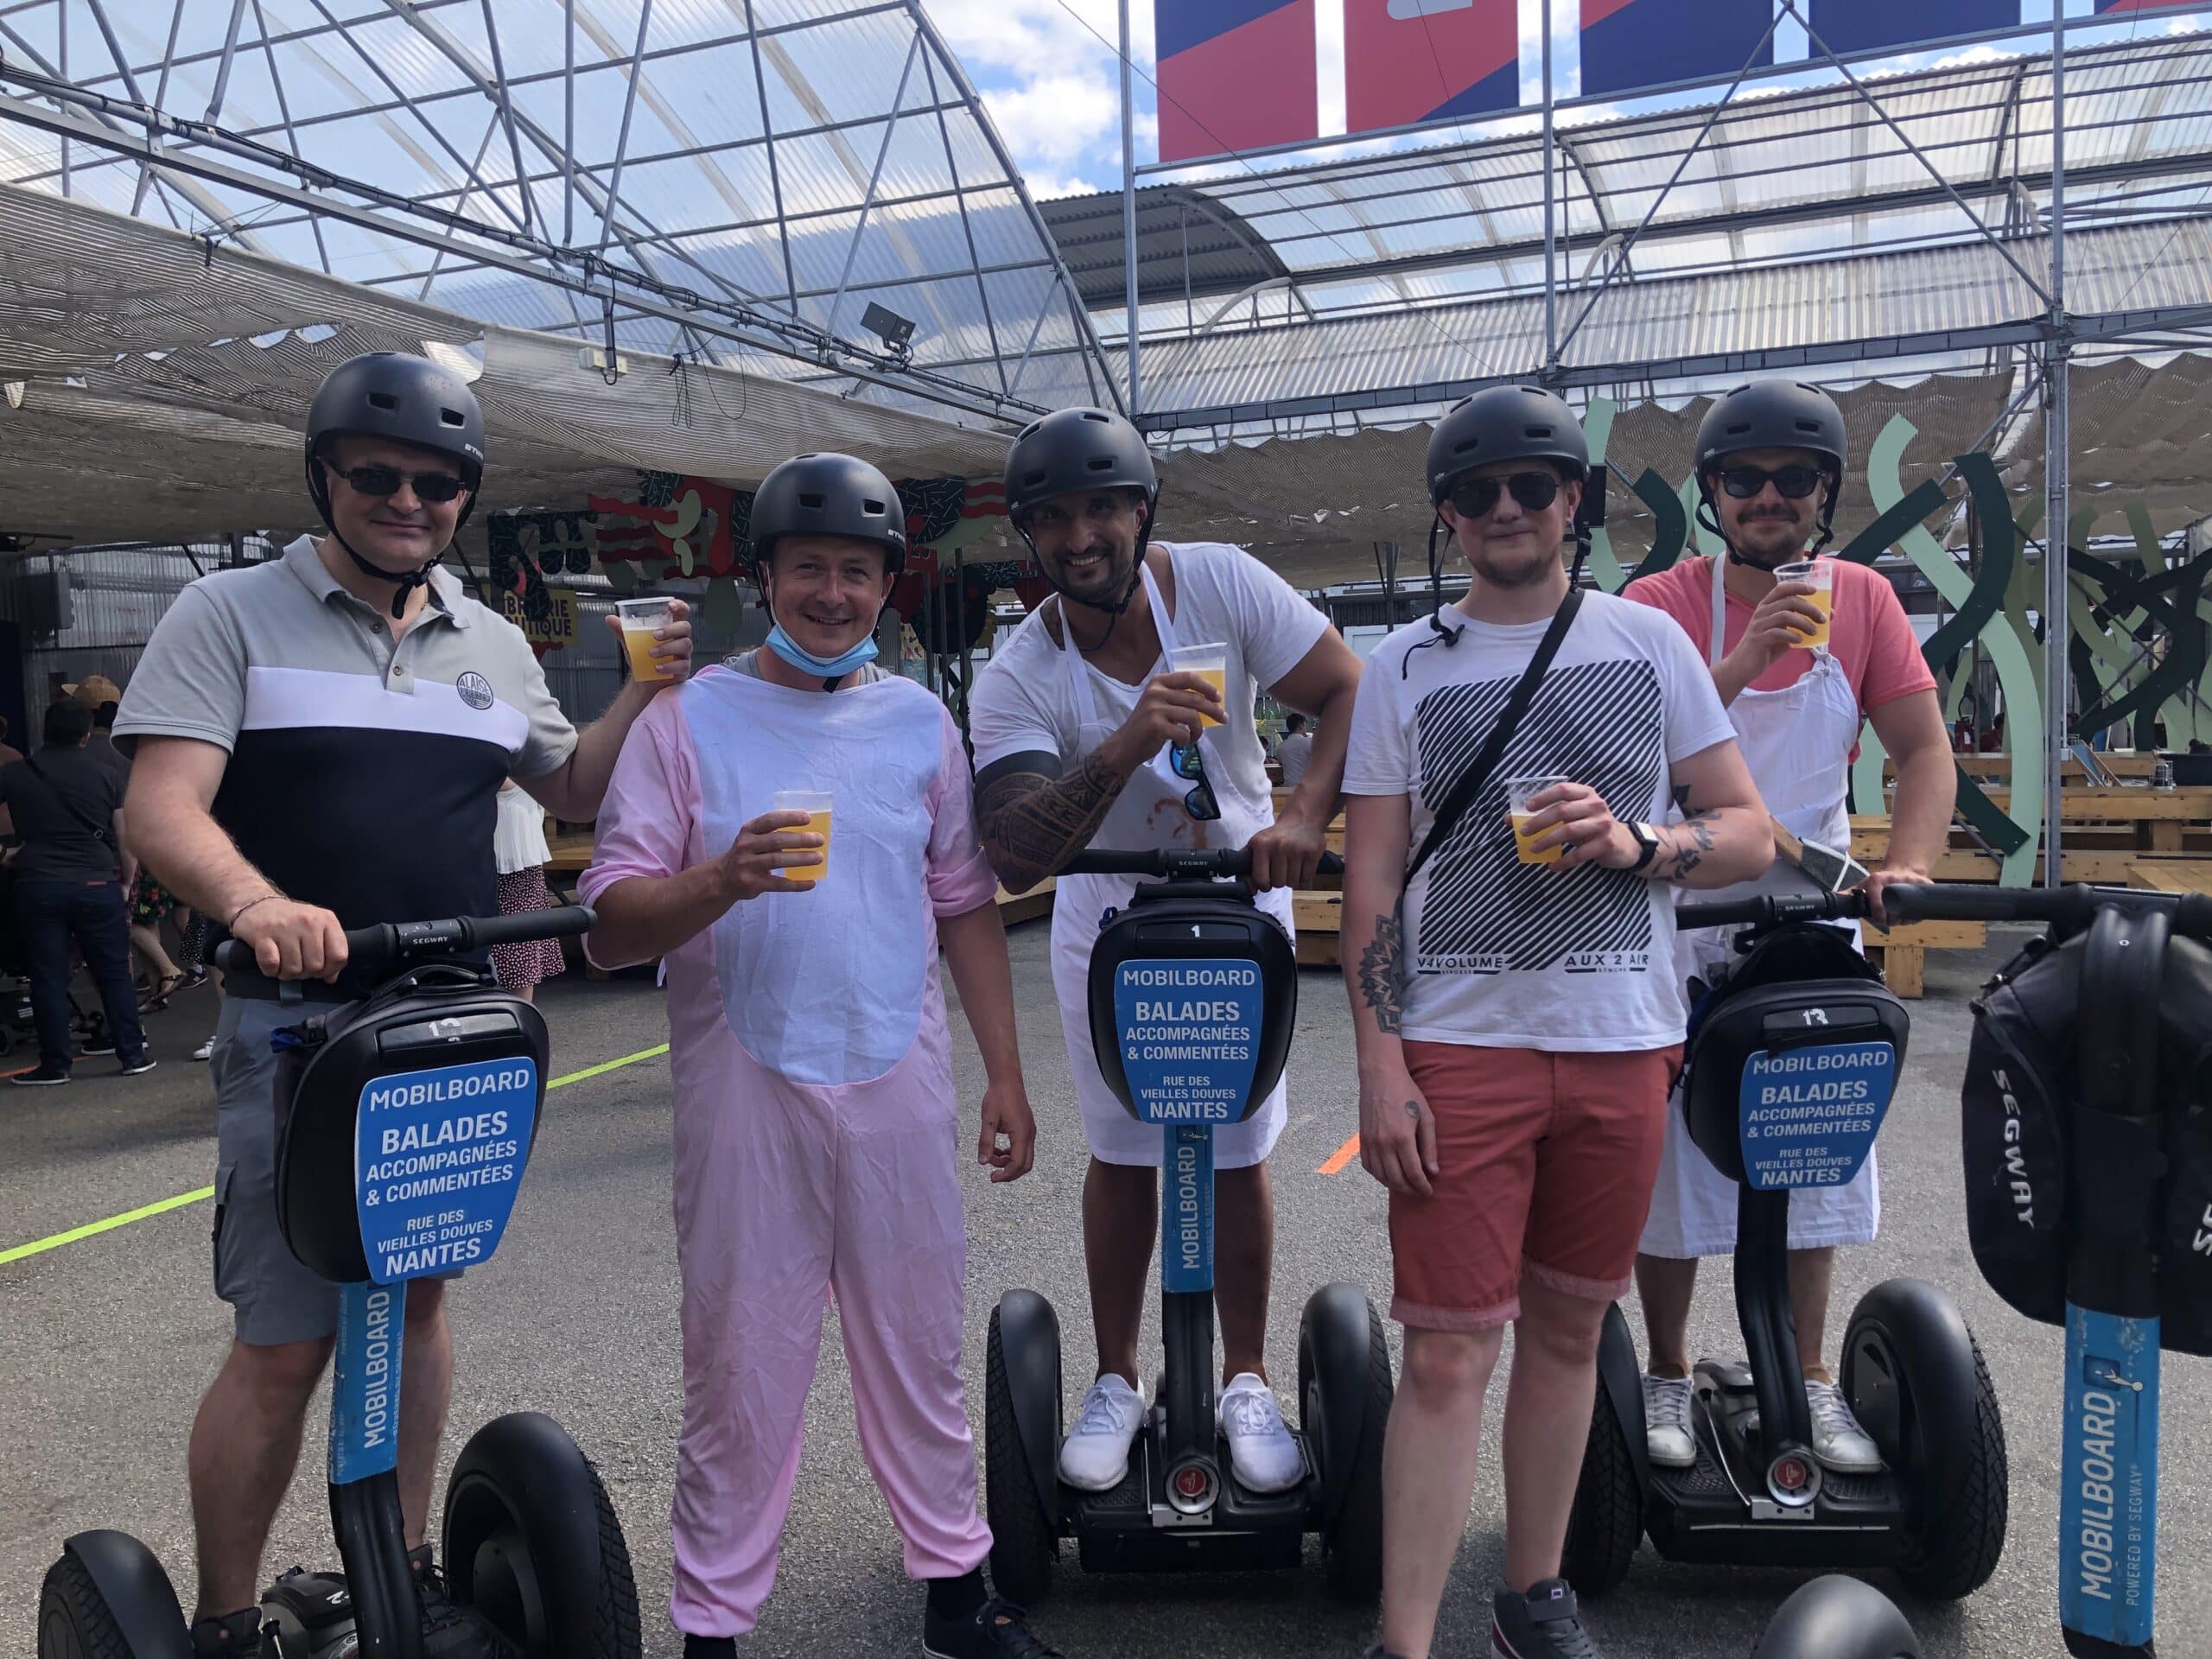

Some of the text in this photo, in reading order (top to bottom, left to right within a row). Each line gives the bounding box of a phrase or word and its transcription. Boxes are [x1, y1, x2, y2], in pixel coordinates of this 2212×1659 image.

[413, 936, 448, 944] SEGWAY
[1190, 925, 1200, 938] 1
[1564, 953, 1649, 967] AUX 2 AIR
[1123, 969, 1255, 986] MOBILBOARD
[1135, 1001, 1241, 1021] BALADES
[1126, 1024, 1250, 1041] ACCOMPAGNÉES
[1127, 1043, 1249, 1060] & COMMENTÉES
[1753, 1052, 1888, 1075] MOBILBOARD
[370, 1069, 530, 1112] MOBILBOARD
[1162, 1075, 1210, 1086] RUE DES
[1141, 1088, 1236, 1099] VIEILLES DOUVES
[1761, 1080, 1868, 1105] BALADES
[1149, 1103, 1228, 1119] NANTES
[1748, 1102, 1875, 1122] ACCOMPAGNÉES
[381, 1110, 508, 1154] BALADES
[1747, 1119, 1871, 1138] & COMMENTÉES
[1779, 1147, 1827, 1158] RUE DES
[1991, 1069, 2035, 1230] SEGWAY
[365, 1140, 518, 1182] ACCOMPAGNÉES
[1755, 1156, 1852, 1170] VIEILLES DOUVES
[365, 1164, 513, 1207] & COMMENTÉES
[1761, 1168, 1840, 1186] NANTES
[1177, 1146, 1200, 1269] MOBILBOARD
[406, 1210, 464, 1231] RUE DES
[377, 1219, 493, 1254] VIEILLES DOUVES
[385, 1237, 480, 1276] NANTES
[364, 1291, 391, 1449] MOBILBOARD
[2081, 1391, 2116, 1600] MOBILBOARD
[2128, 1526, 2141, 1541] BY
[2126, 1548, 2141, 1605] POWERED
